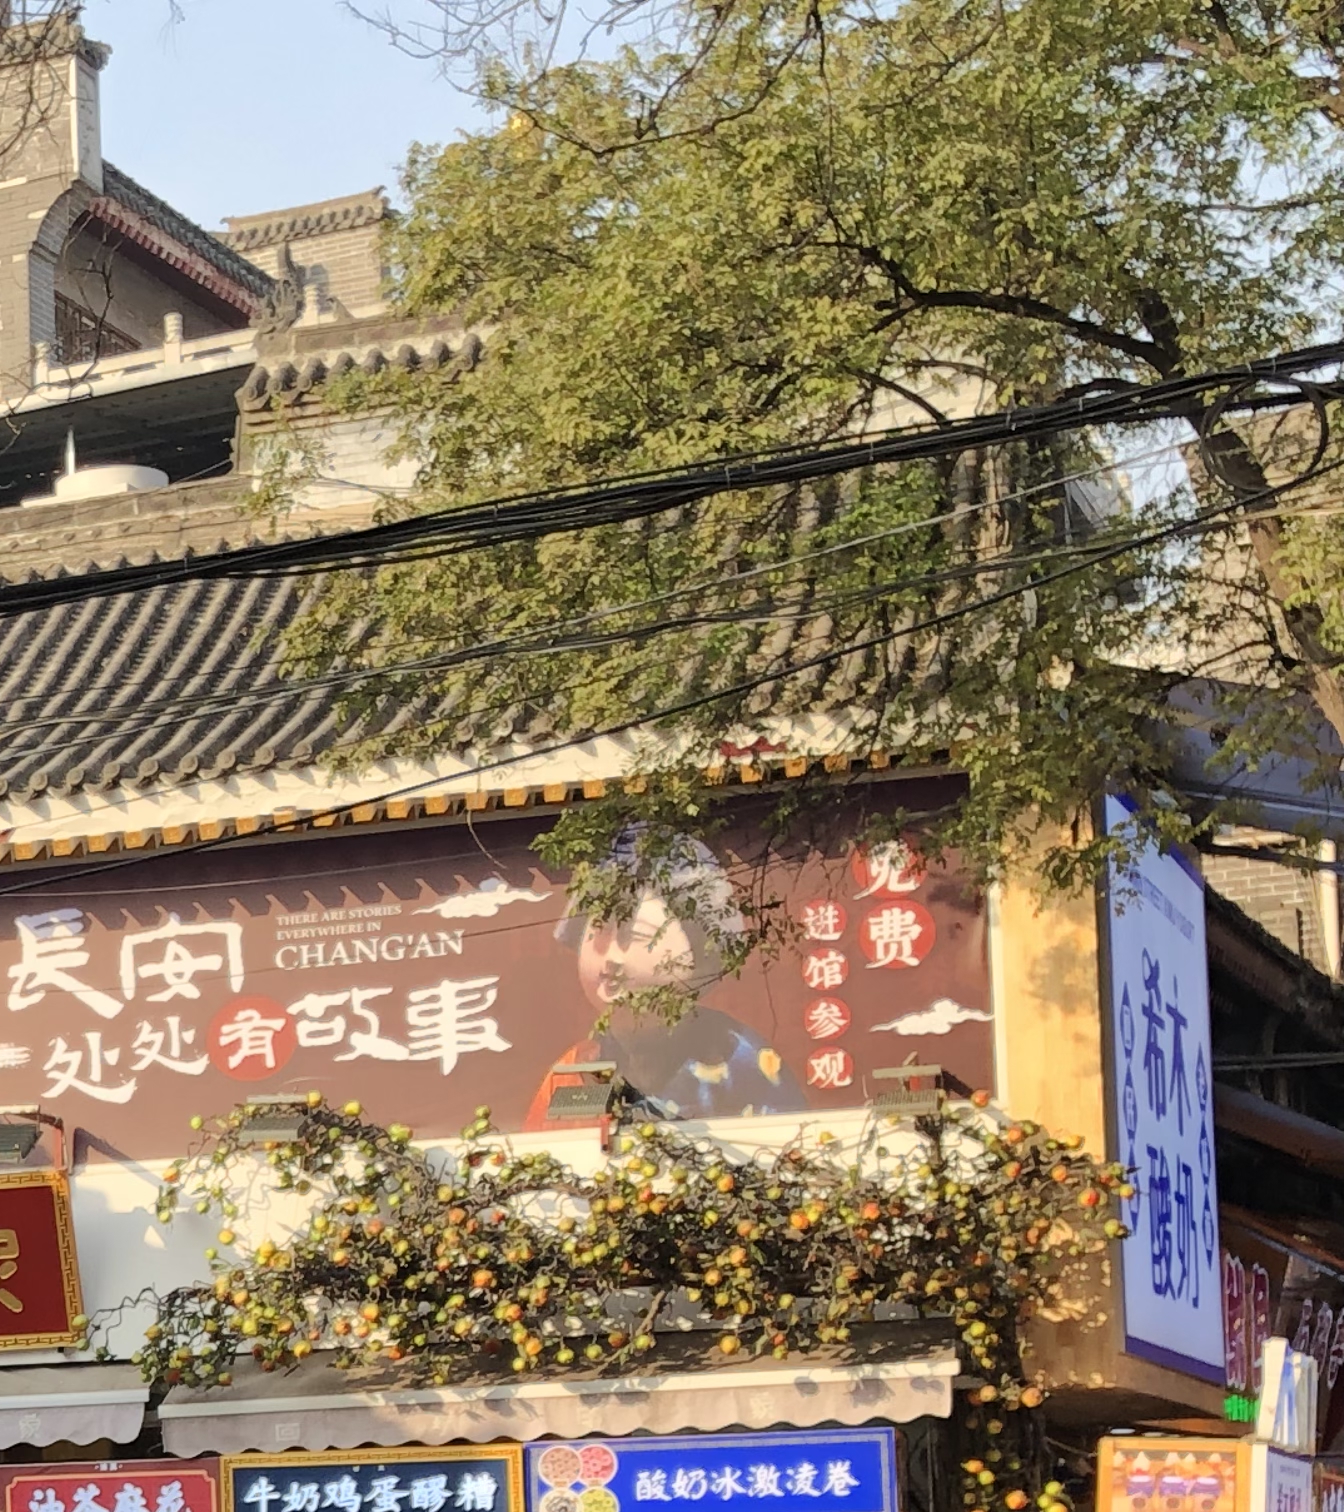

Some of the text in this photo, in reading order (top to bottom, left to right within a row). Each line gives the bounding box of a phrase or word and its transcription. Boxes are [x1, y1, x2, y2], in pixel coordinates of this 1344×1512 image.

[276, 904, 402, 926] THERE ARE STORIES
[276, 921, 382, 940] EVERYWHERE IN
[275, 930, 465, 970] CHANG'AN
[804, 903, 853, 1089] 进馆参观
[42, 975, 511, 1103] 处处有故事
[635, 1460, 860, 1501] 酸奶冰激凌卷
